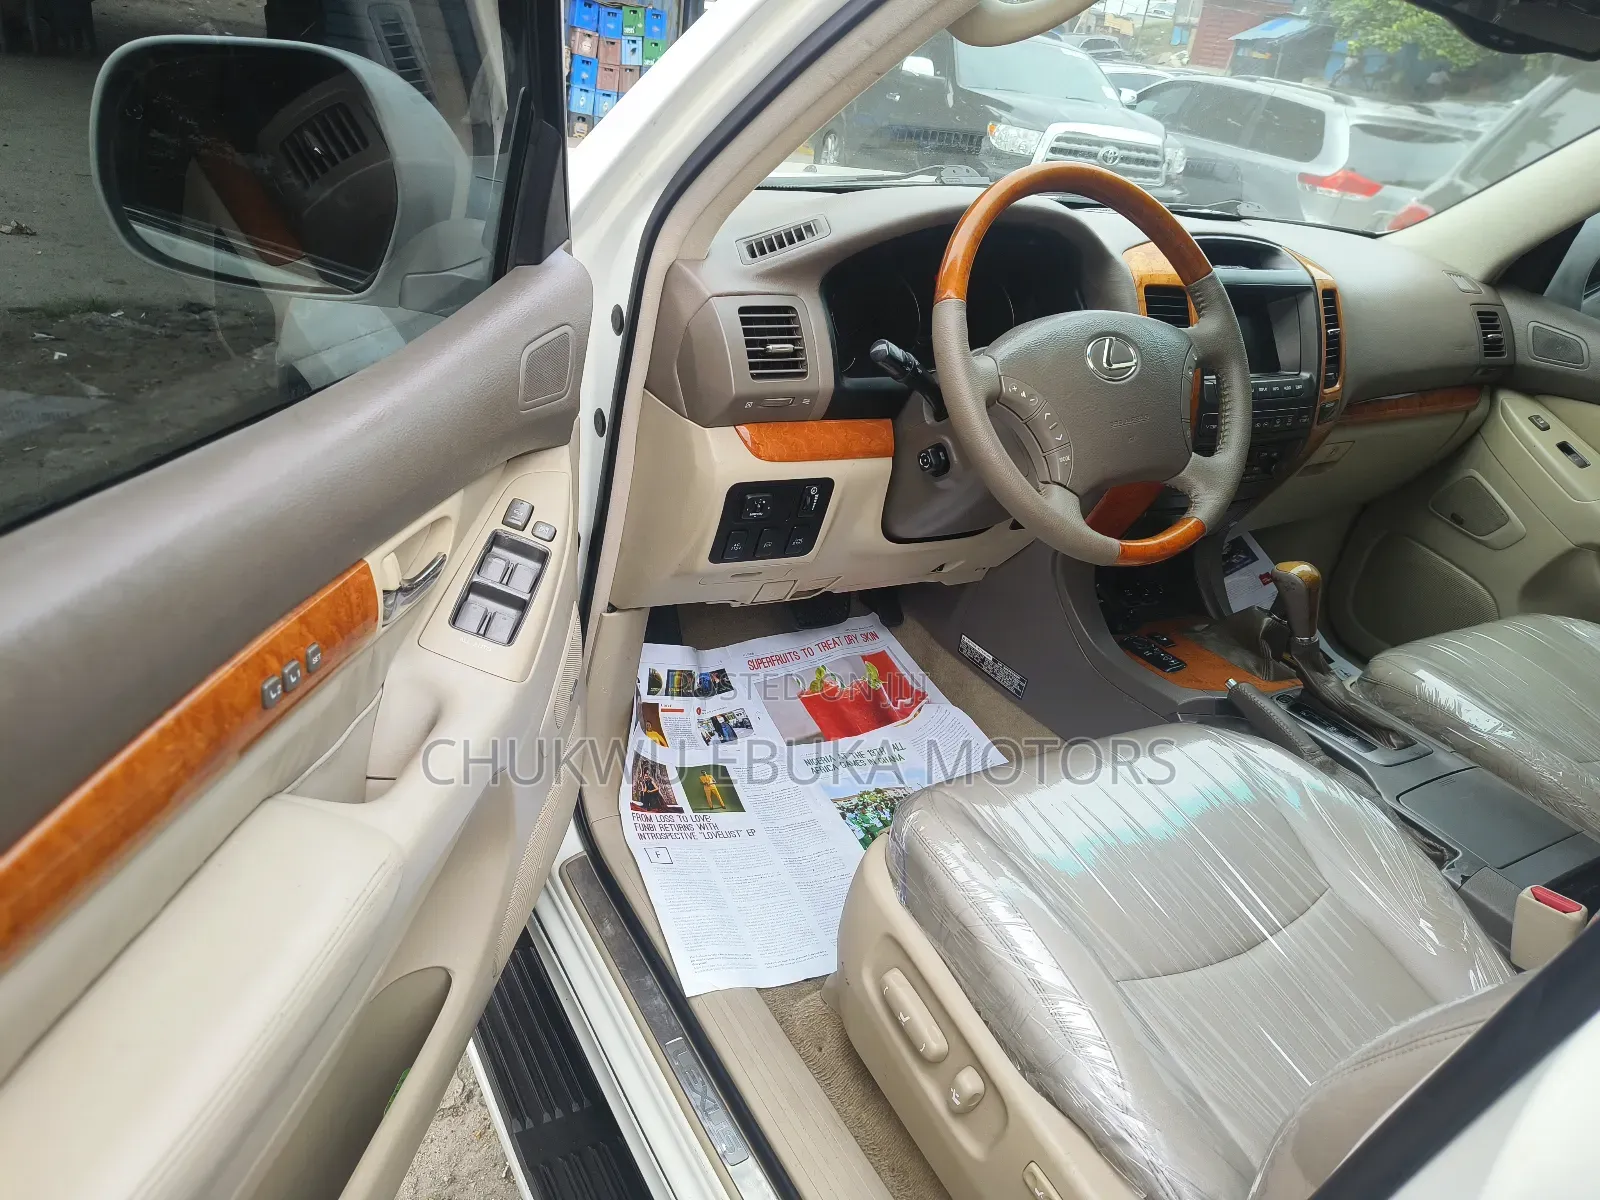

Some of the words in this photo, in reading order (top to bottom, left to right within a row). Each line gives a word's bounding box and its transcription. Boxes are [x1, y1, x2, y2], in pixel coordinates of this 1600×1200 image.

[747, 651, 801, 671] SUPERFRUITS
[800, 647, 816, 659] TO
[816, 636, 844, 653] TREAT
[843, 633, 860, 645] DRY
[861, 630, 880, 643] SKIN
[312, 652, 322, 665] SET
[290, 669, 301, 683] L1
[270, 684, 282, 699] L2
[803, 754, 836, 767] NIGERIA
[849, 750, 866, 759] THE
[892, 742, 907, 752] ALL
[810, 766, 840, 775] AFRICA
[839, 759, 867, 768] GAMES
[631, 813, 653, 822] FROM
[634, 823, 657, 832] FUNBI
[659, 823, 695, 831] RETURNS
[696, 822, 720, 830] WITH
[637, 832, 698, 840] INTROSPECTIVE
[746, 828, 757, 837] EP
